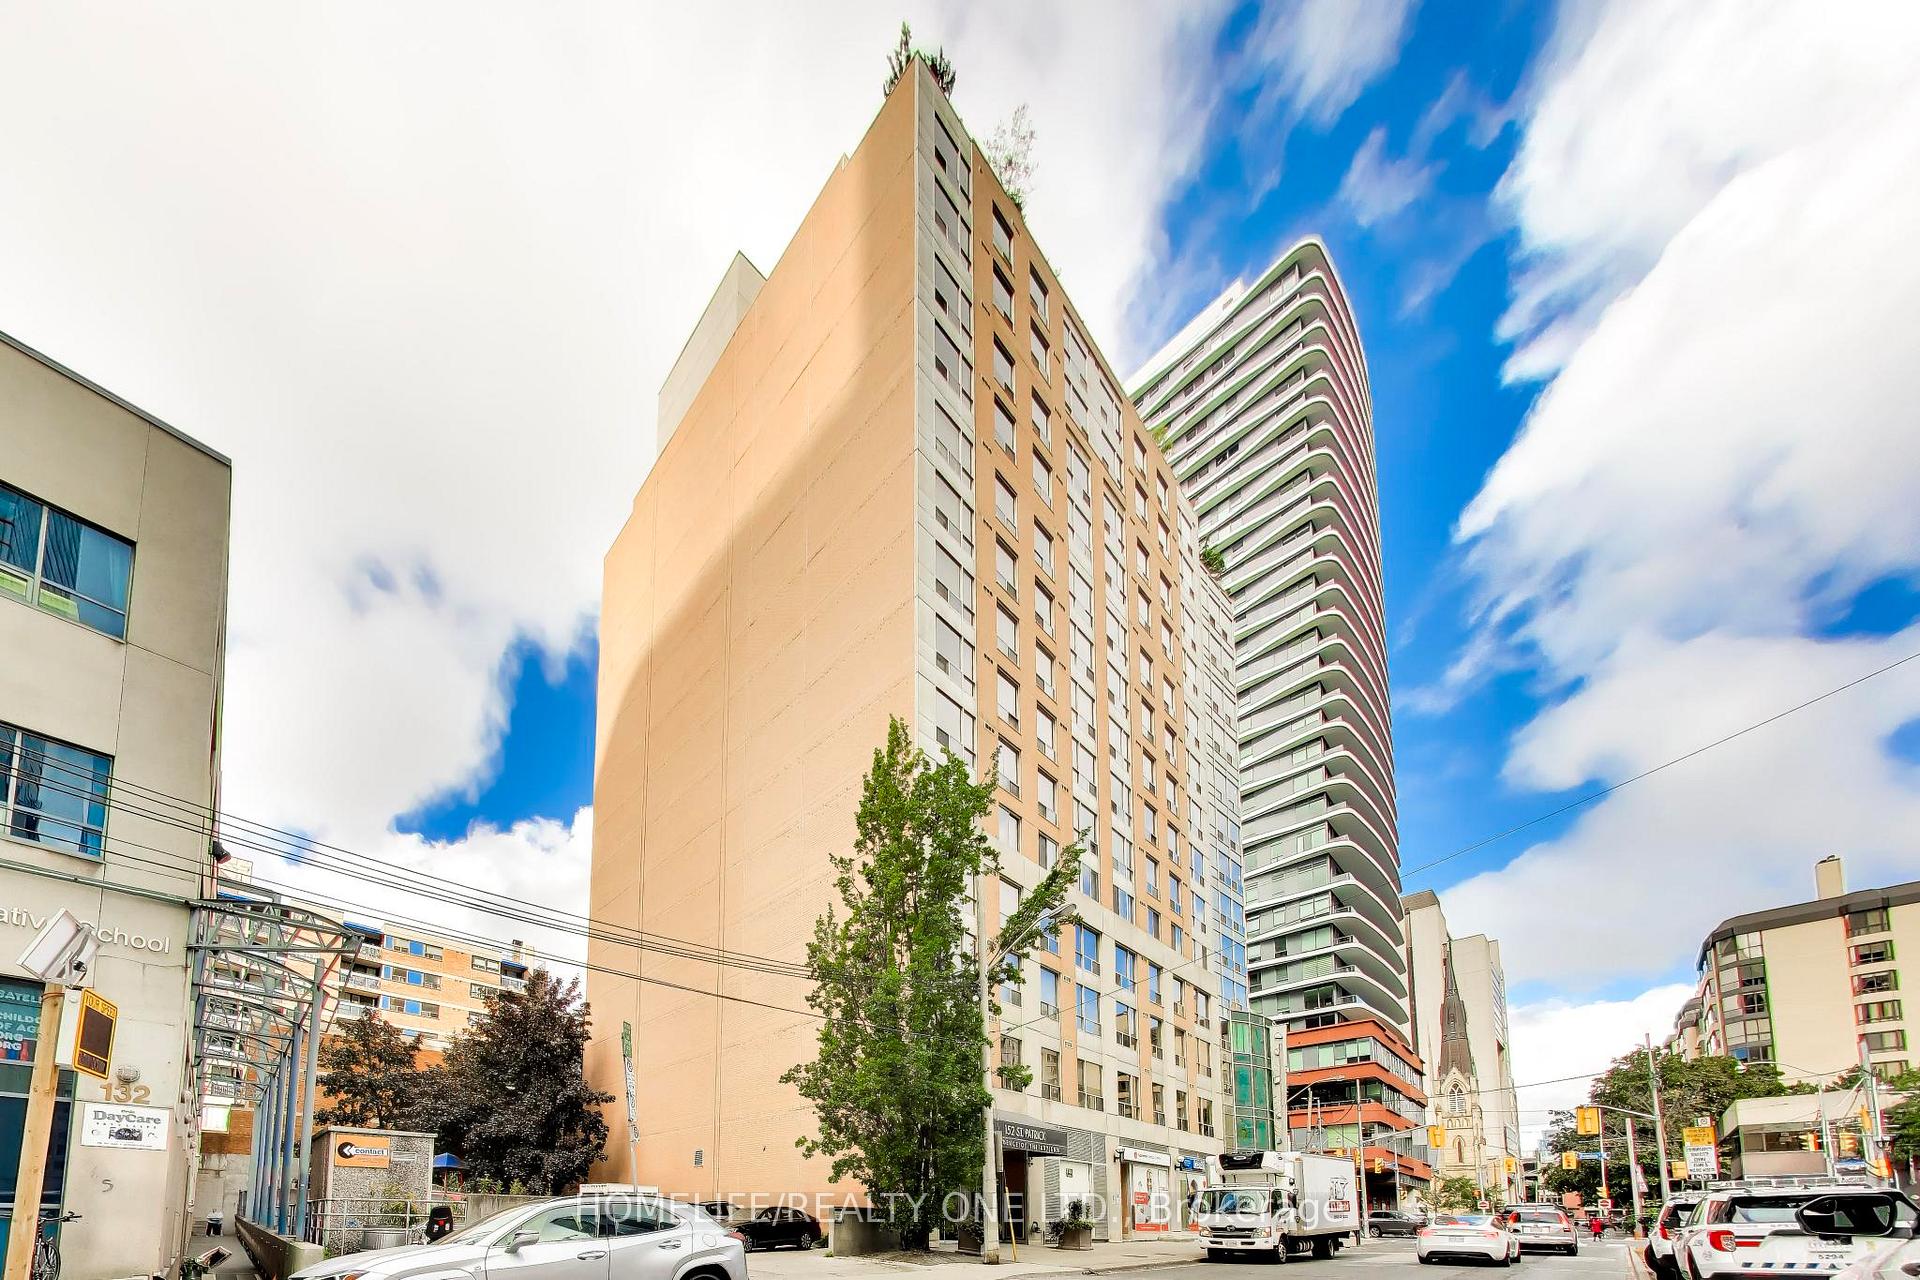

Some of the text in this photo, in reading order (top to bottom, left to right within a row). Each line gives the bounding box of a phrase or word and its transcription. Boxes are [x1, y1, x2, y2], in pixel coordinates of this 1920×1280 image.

[0, 905, 47, 929] ativ
[99, 1082, 151, 1104] 132
[93, 1109, 161, 1125] DayCare
[1005, 1124, 1015, 1136] 152
[355, 1147, 384, 1155] contact
